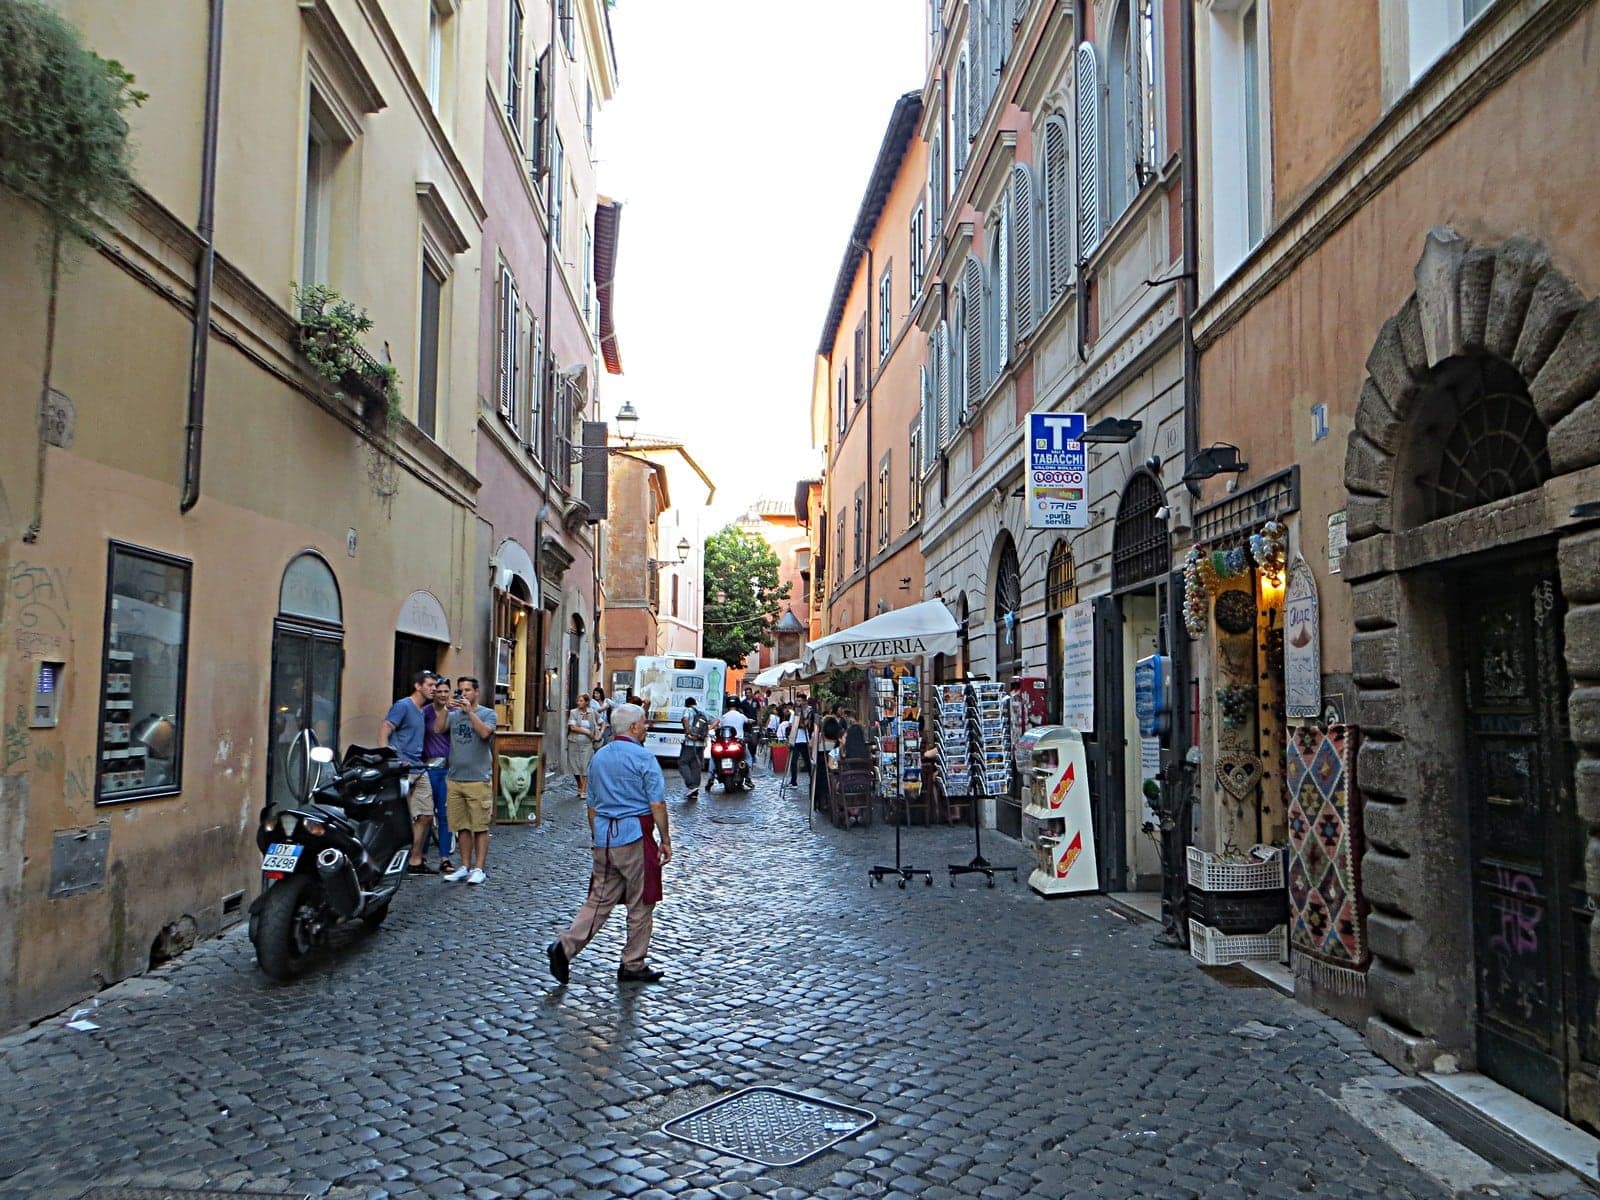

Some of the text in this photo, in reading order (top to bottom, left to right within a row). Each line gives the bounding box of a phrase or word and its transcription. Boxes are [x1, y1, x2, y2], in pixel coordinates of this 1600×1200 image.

[1311, 405, 1329, 441] 1
[1044, 417, 1071, 449] T
[1033, 454, 1083, 464] TABACCHI
[1034, 472, 1082, 483] LOTTO
[1050, 502, 1077, 510] TRIS
[841, 637, 927, 659] PIZZERIA
